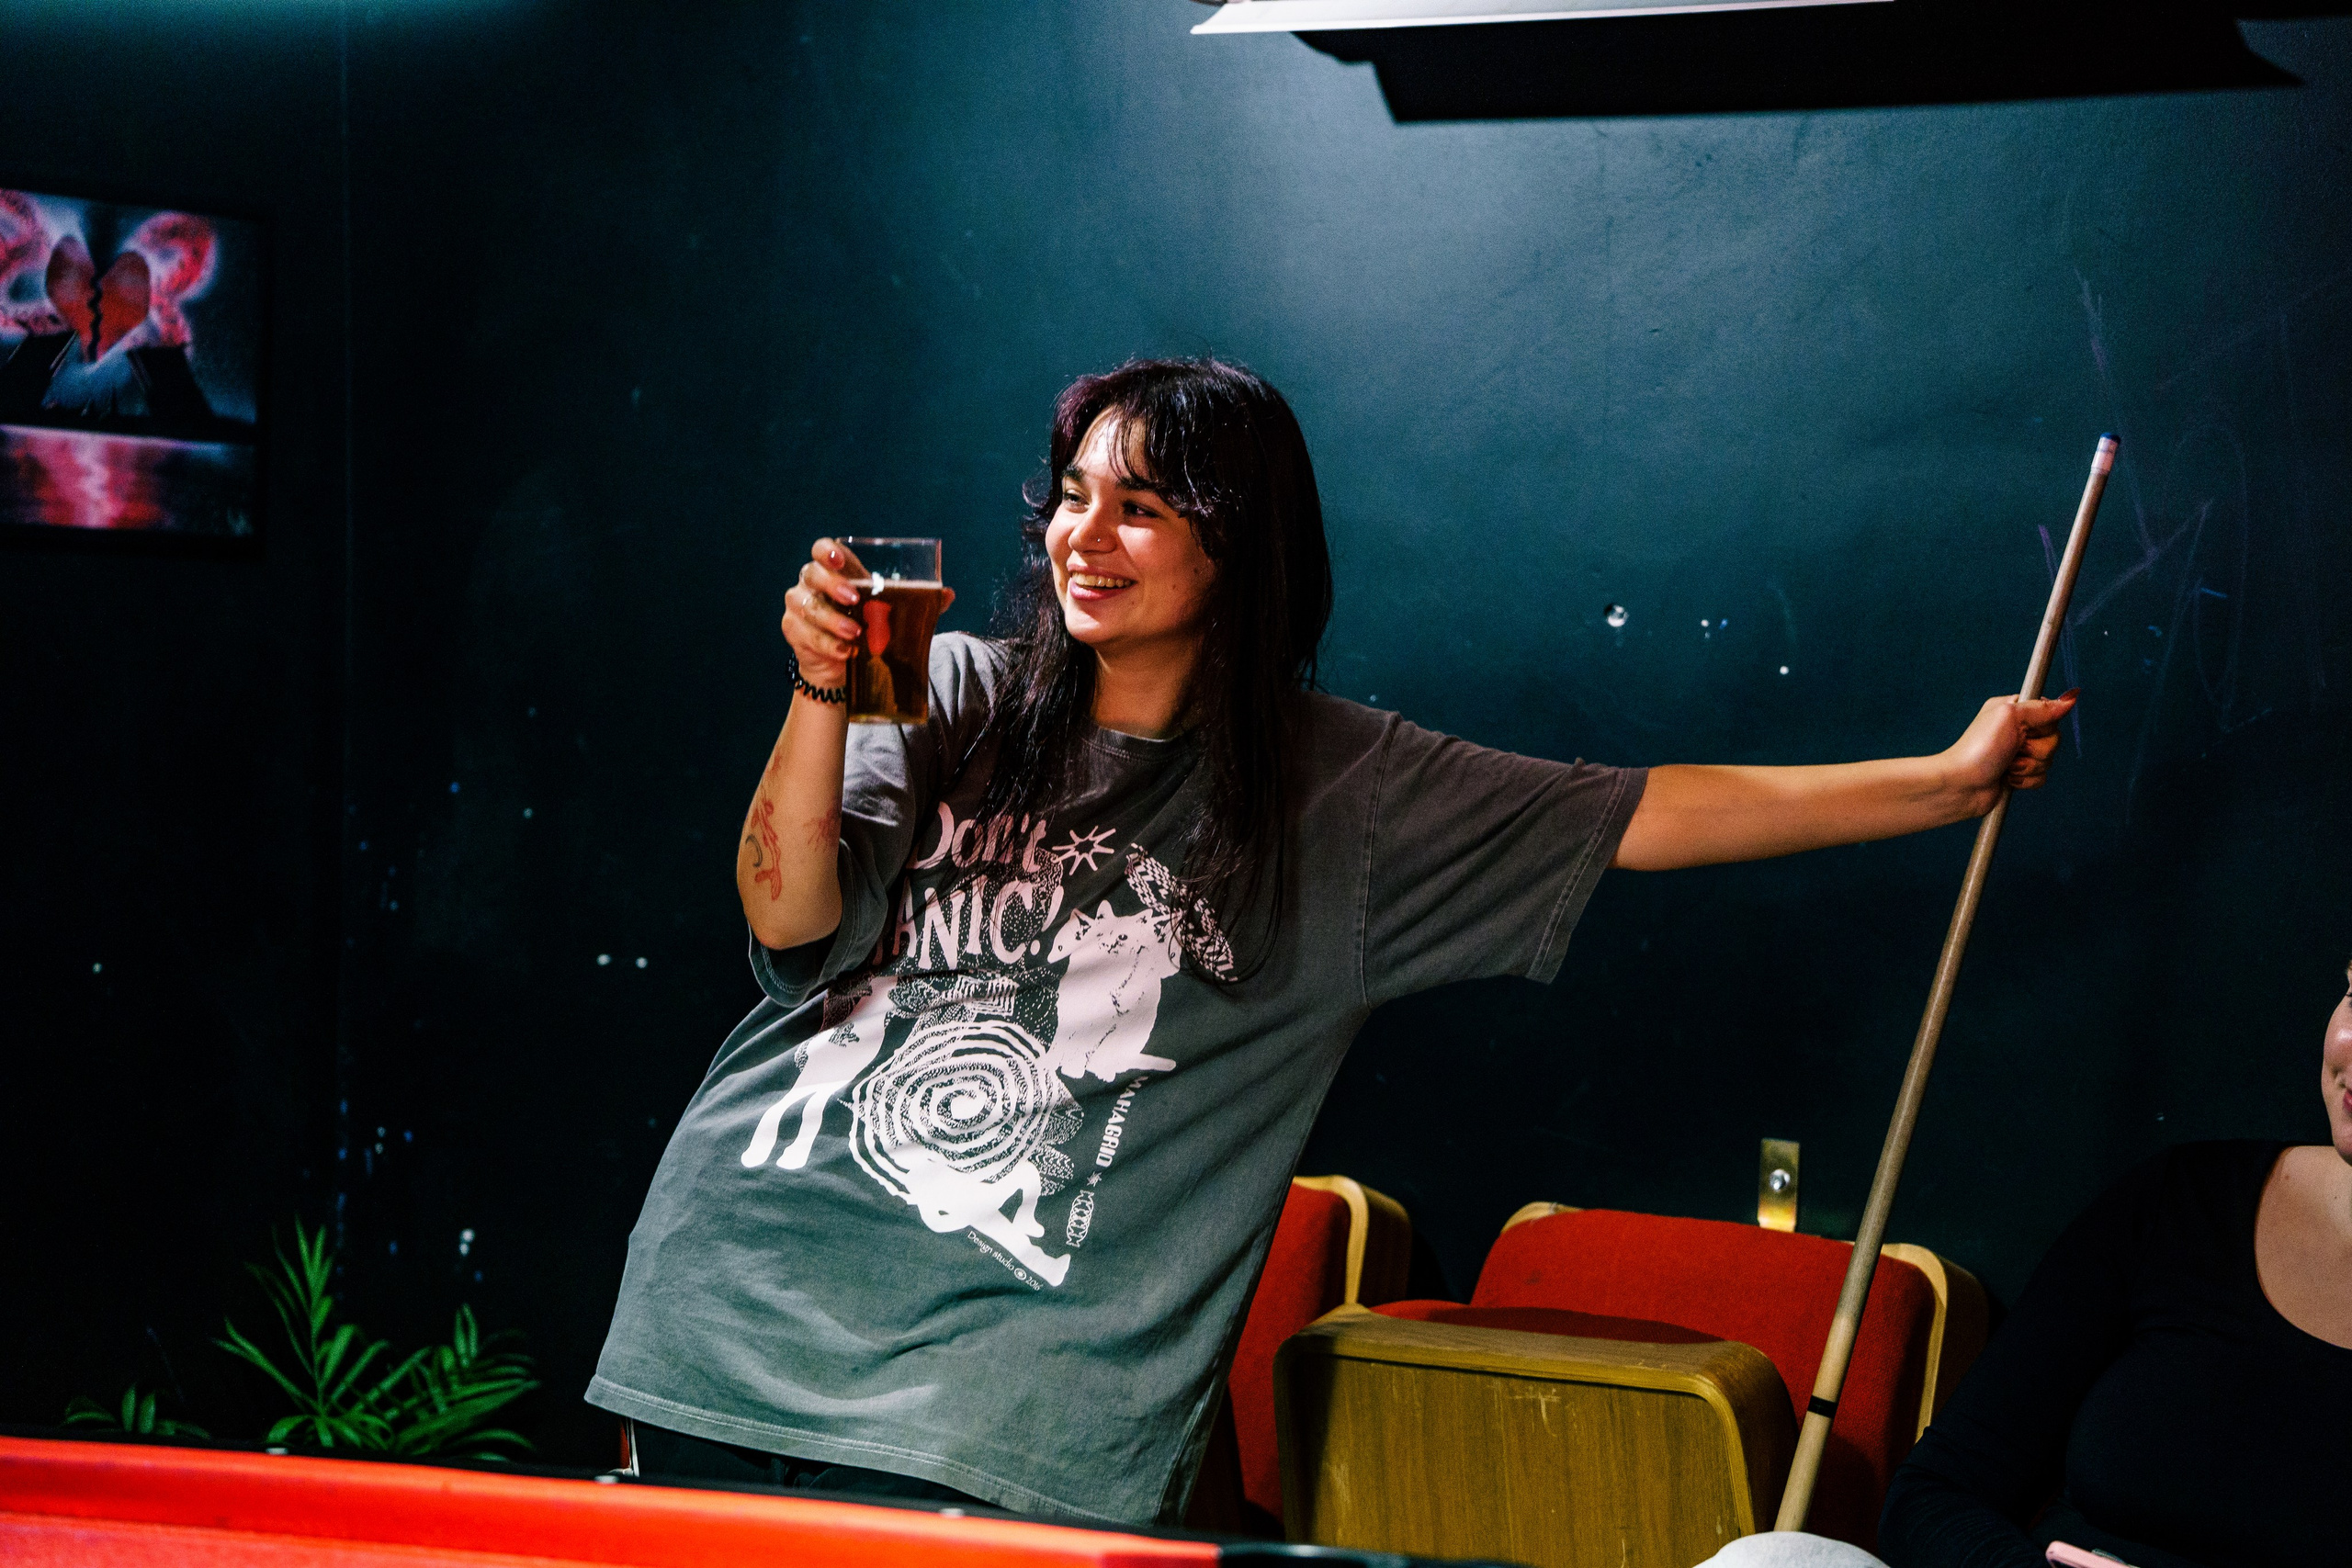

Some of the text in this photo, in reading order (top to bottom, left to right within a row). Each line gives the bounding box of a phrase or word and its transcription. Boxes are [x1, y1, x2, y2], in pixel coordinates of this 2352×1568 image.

[874, 874, 1065, 969] ANIC!
[967, 1230, 993, 1254] Design
[991, 1250, 1015, 1271] studio
